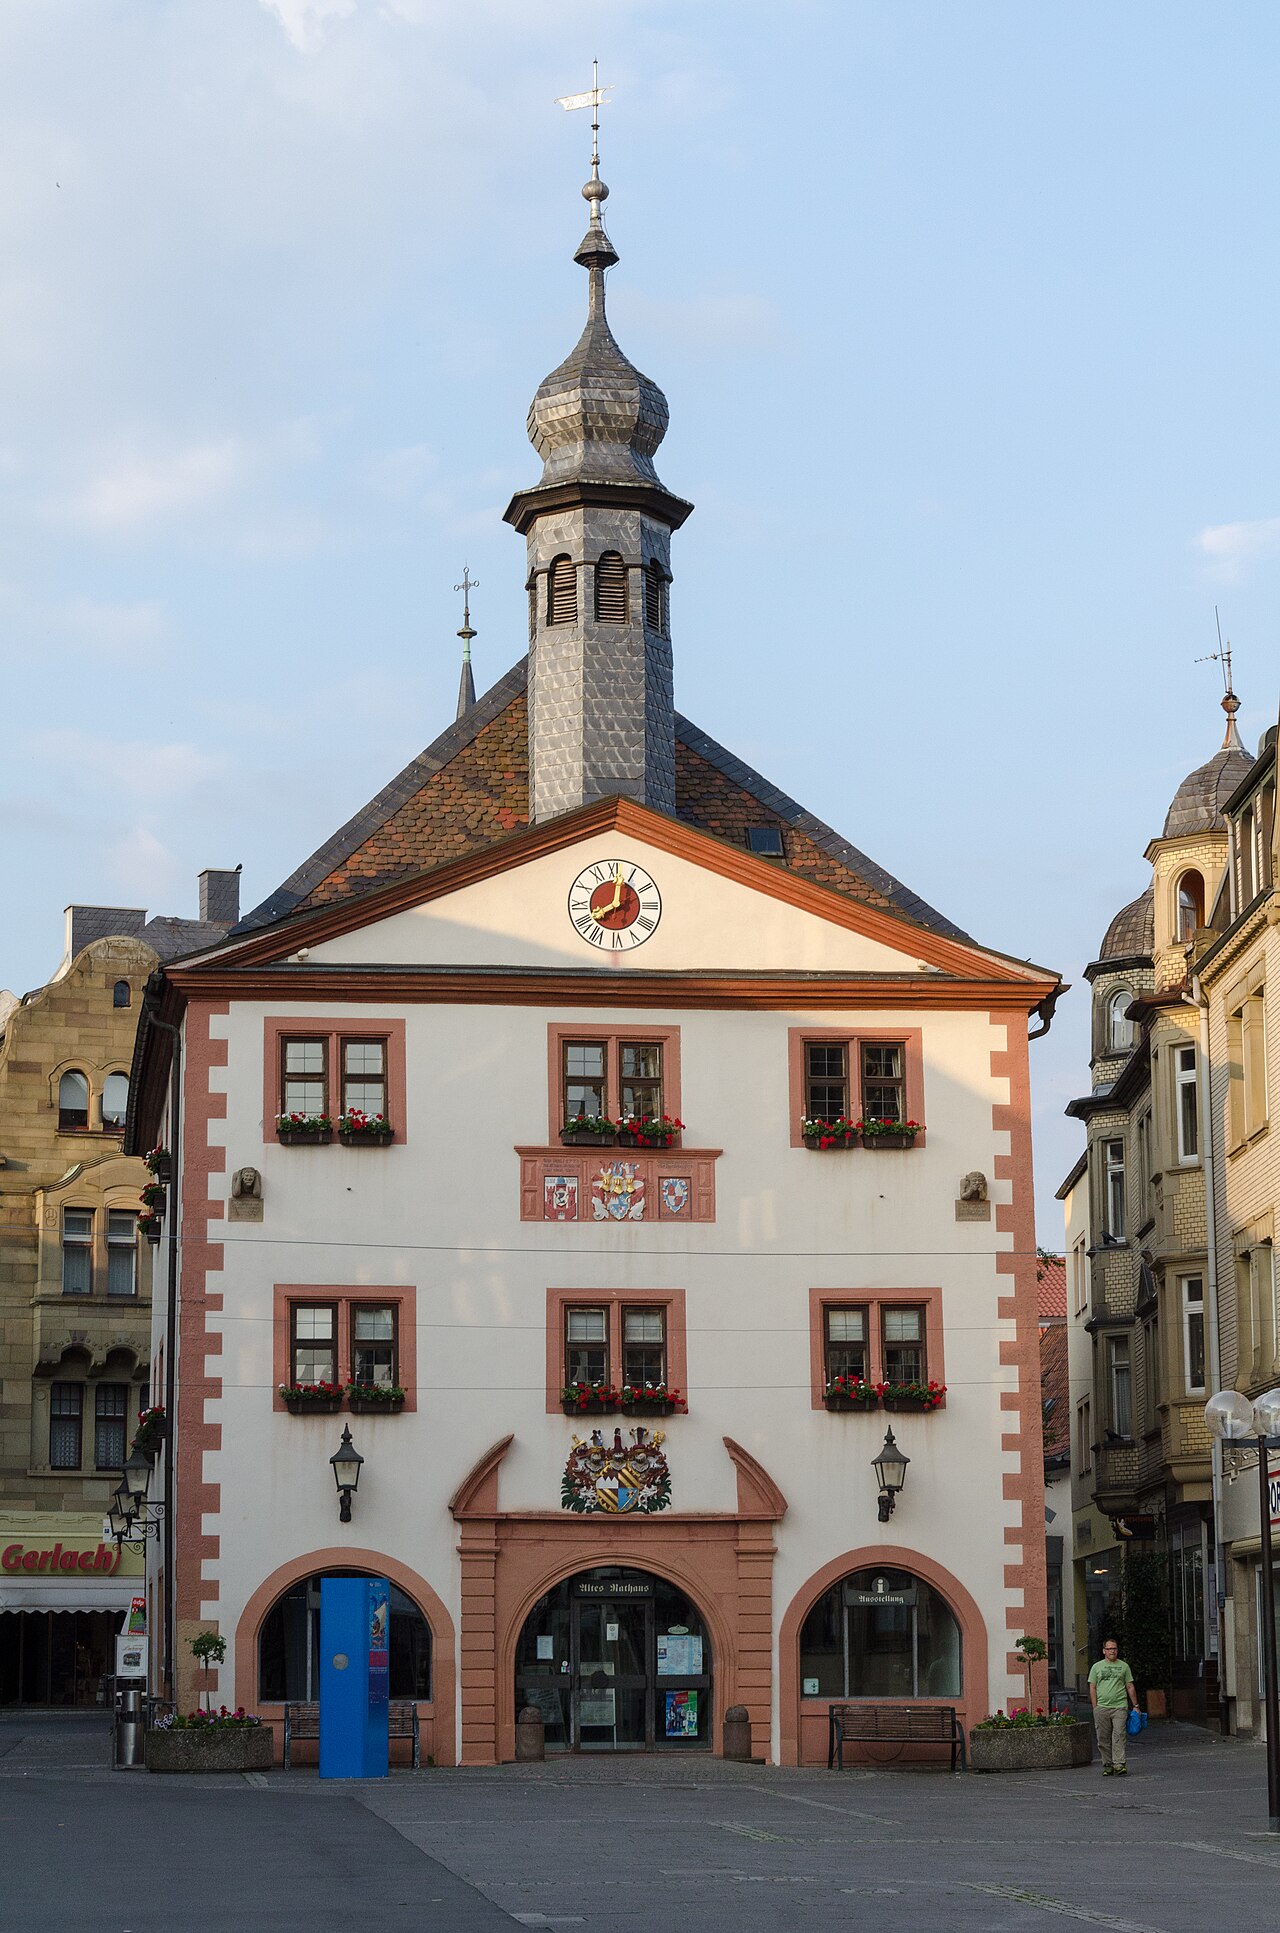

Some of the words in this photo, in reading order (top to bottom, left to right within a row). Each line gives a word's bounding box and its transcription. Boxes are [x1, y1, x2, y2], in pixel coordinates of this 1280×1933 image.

[607, 862, 620, 878] XI
[628, 867, 637, 882] I
[575, 880, 593, 895] X
[638, 882, 653, 894] II
[641, 901, 659, 910] III
[1, 1543, 114, 1570] Gerlach
[579, 1583, 604, 1593] Altes
[609, 1583, 650, 1594] Rathaus
[858, 1595, 904, 1604] Ausstellung
